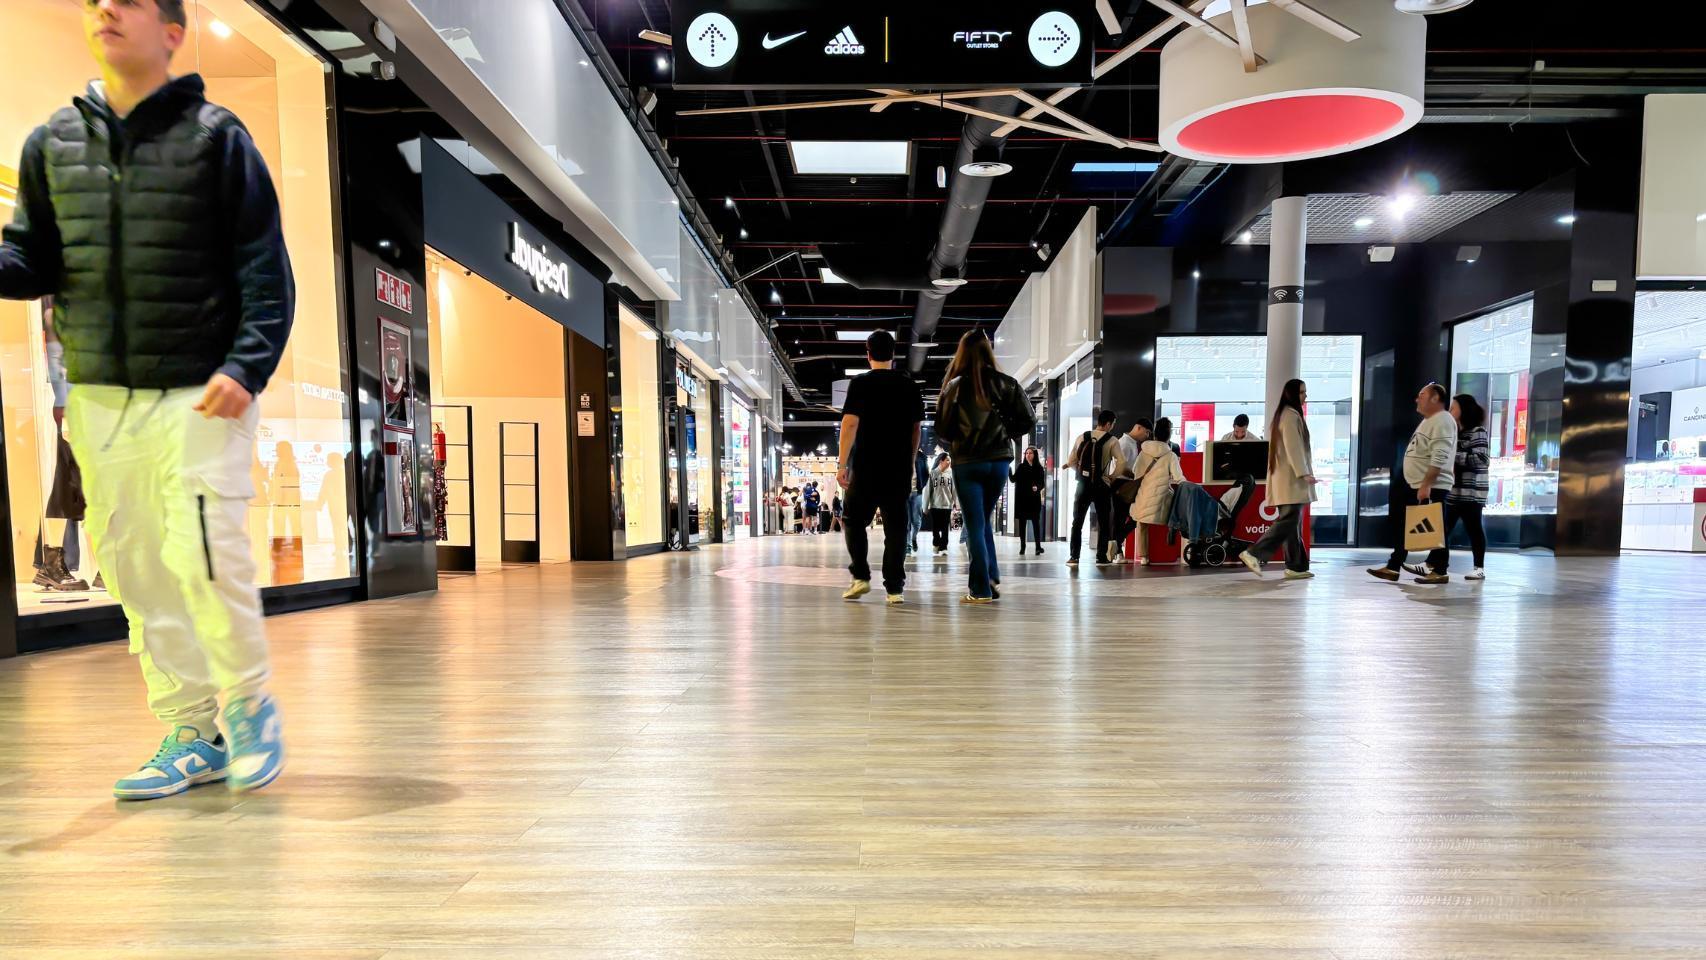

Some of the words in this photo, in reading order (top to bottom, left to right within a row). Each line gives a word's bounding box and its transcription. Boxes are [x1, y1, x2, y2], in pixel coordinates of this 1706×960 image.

[953, 31, 1012, 42] FIFTY
[824, 43, 865, 54] adidas
[1684, 414, 1706, 422] CANDIN
[1245, 524, 1270, 534] voda
